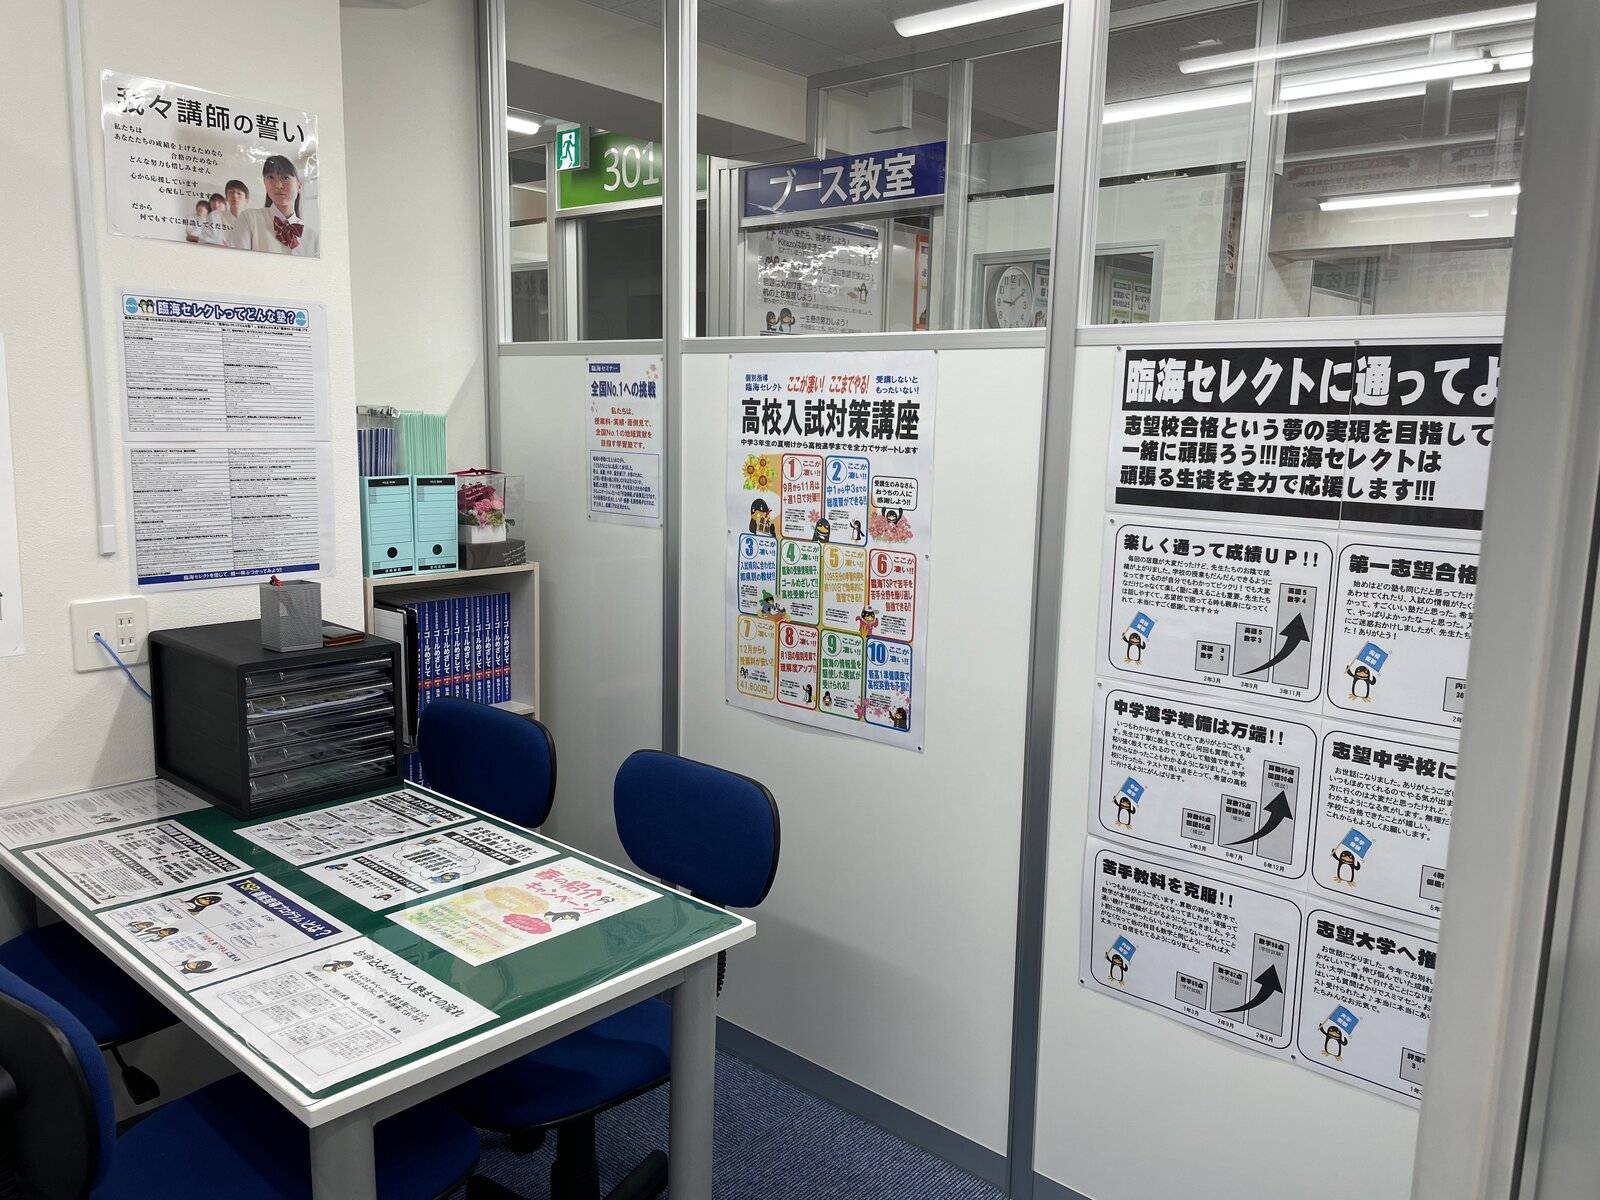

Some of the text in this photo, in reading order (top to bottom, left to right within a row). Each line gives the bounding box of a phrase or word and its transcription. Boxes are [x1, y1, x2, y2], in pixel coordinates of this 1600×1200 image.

[114, 123, 142, 135] 私たちは
[114, 134, 223, 158] あなたたちの成績を上げるためなら
[129, 156, 211, 176] どんな努力も惜しみません
[171, 152, 219, 167] 合格のためなら
[603, 141, 661, 193] 301
[130, 172, 199, 188] 心から応援しています
[769, 153, 916, 212] ブース教室
[132, 202, 153, 212] だから
[156, 299, 296, 325] 臨海セレクトってどんな塾?
[591, 381, 657, 399] 全国No.1への挑戦
[745, 383, 920, 396] 臨海セレクト もったいない!
[876, 376, 918, 385] 受講しないと
[1126, 355, 1500, 408] 臨海セレクトに通ってよ
[741, 398, 921, 441] 高校入試対策講座
[1124, 415, 1493, 447] 志望校合格という夢の実現を目指して
[802, 460, 821, 469] ここが
[847, 462, 867, 471] ここが
[1121, 440, 1443, 474] 一緒に頑張ろう!!!臨海セレクトは
[788, 459, 796, 478] 1
[832, 461, 842, 482] 2
[783, 481, 820, 493] 9月から11月は
[827, 483, 867, 496] 中1から中3までの
[875, 489, 913, 498] おうちの人に
[1119, 465, 1437, 502] 頑張る生徒を全力で応援します!!!
[877, 497, 911, 506] 感謝しよう!!
[745, 538, 754, 556] 3
[759, 539, 776, 548] ここが
[787, 543, 796, 562] 4
[801, 545, 819, 553] ここが
[1123, 533, 1319, 568] 楽しく通って成績UP!!
[830, 548, 839, 568] 5
[845, 551, 864, 559] ここが
[878, 554, 887, 575] 6
[893, 556, 914, 565] ここが
[1348, 553, 1479, 585] 第一志望合格
[1346, 588, 1475, 609] あわせてくれたり、入試の情報がたく
[1352, 579, 1474, 600] 始めはどの塾も同じだと思ってたけ
[743, 619, 751, 638] 7
[757, 622, 775, 631] ここが
[785, 627, 794, 646] 8
[799, 629, 817, 639] ここが
[1344, 616, 1473, 640] にご迷惑おかけしましたが、先生たち
[828, 635, 837, 654] 9
[842, 637, 861, 646] ここが
[889, 646, 909, 656] ここが
[433, 630, 441, 676] ゴールめざして
[868, 643, 886, 664] 10
[1113, 698, 1285, 747] 中学進学準備は万端!!
[1332, 741, 1457, 783] 志望中学校に
[1329, 775, 1454, 810] いつもほめてくれるのでやる気が出ま
[1325, 810, 1431, 844] これからもよろしくお願いします。
[1326, 801, 1431, 834] 学校に合格できたことが嬉しい。
[1102, 857, 1233, 910] 苦手教科を克服!!
[1316, 919, 1438, 972] 志望大学へ推
[1322, 945, 1434, 987] お世話になりました。今年でお別れ
[351, 948, 466, 1019] お申込みからご入塾までの流れ
[1312, 986, 1382, 1017] たちみんなお元気で。
